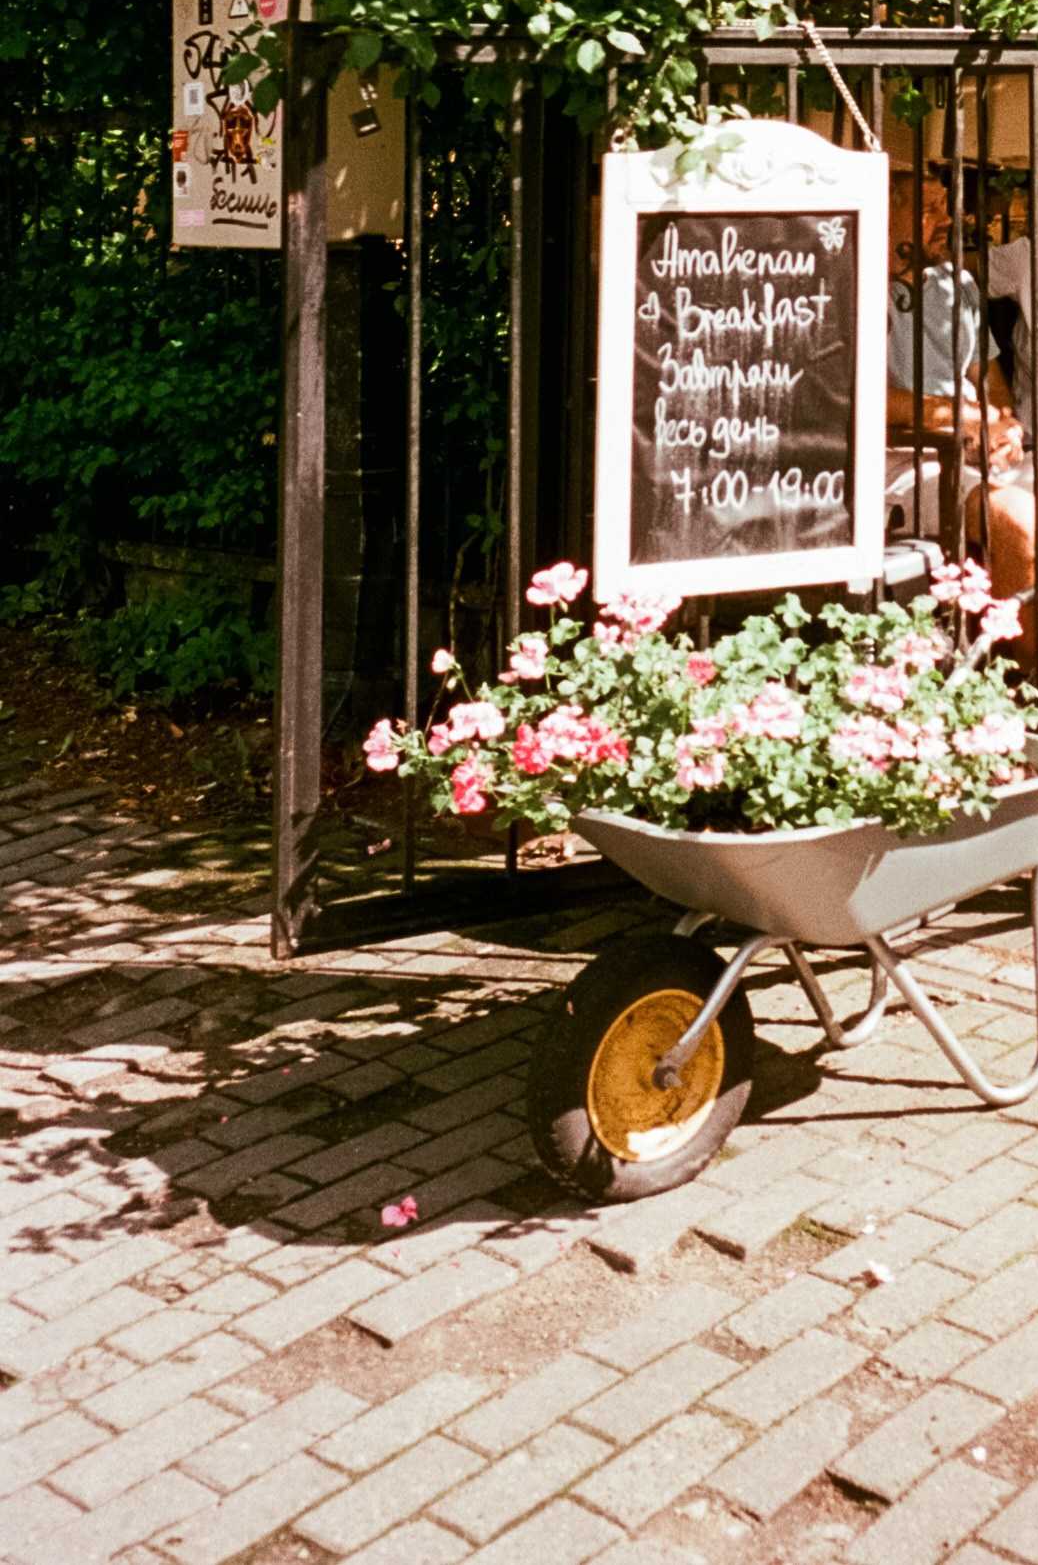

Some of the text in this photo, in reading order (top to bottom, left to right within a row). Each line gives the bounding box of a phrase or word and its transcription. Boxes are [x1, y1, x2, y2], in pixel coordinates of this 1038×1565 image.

[651, 221, 815, 279] Amalienau
[676, 278, 831, 348] Breakfast
[657, 342, 803, 405] Завтраки
[709, 413, 779, 460] день
